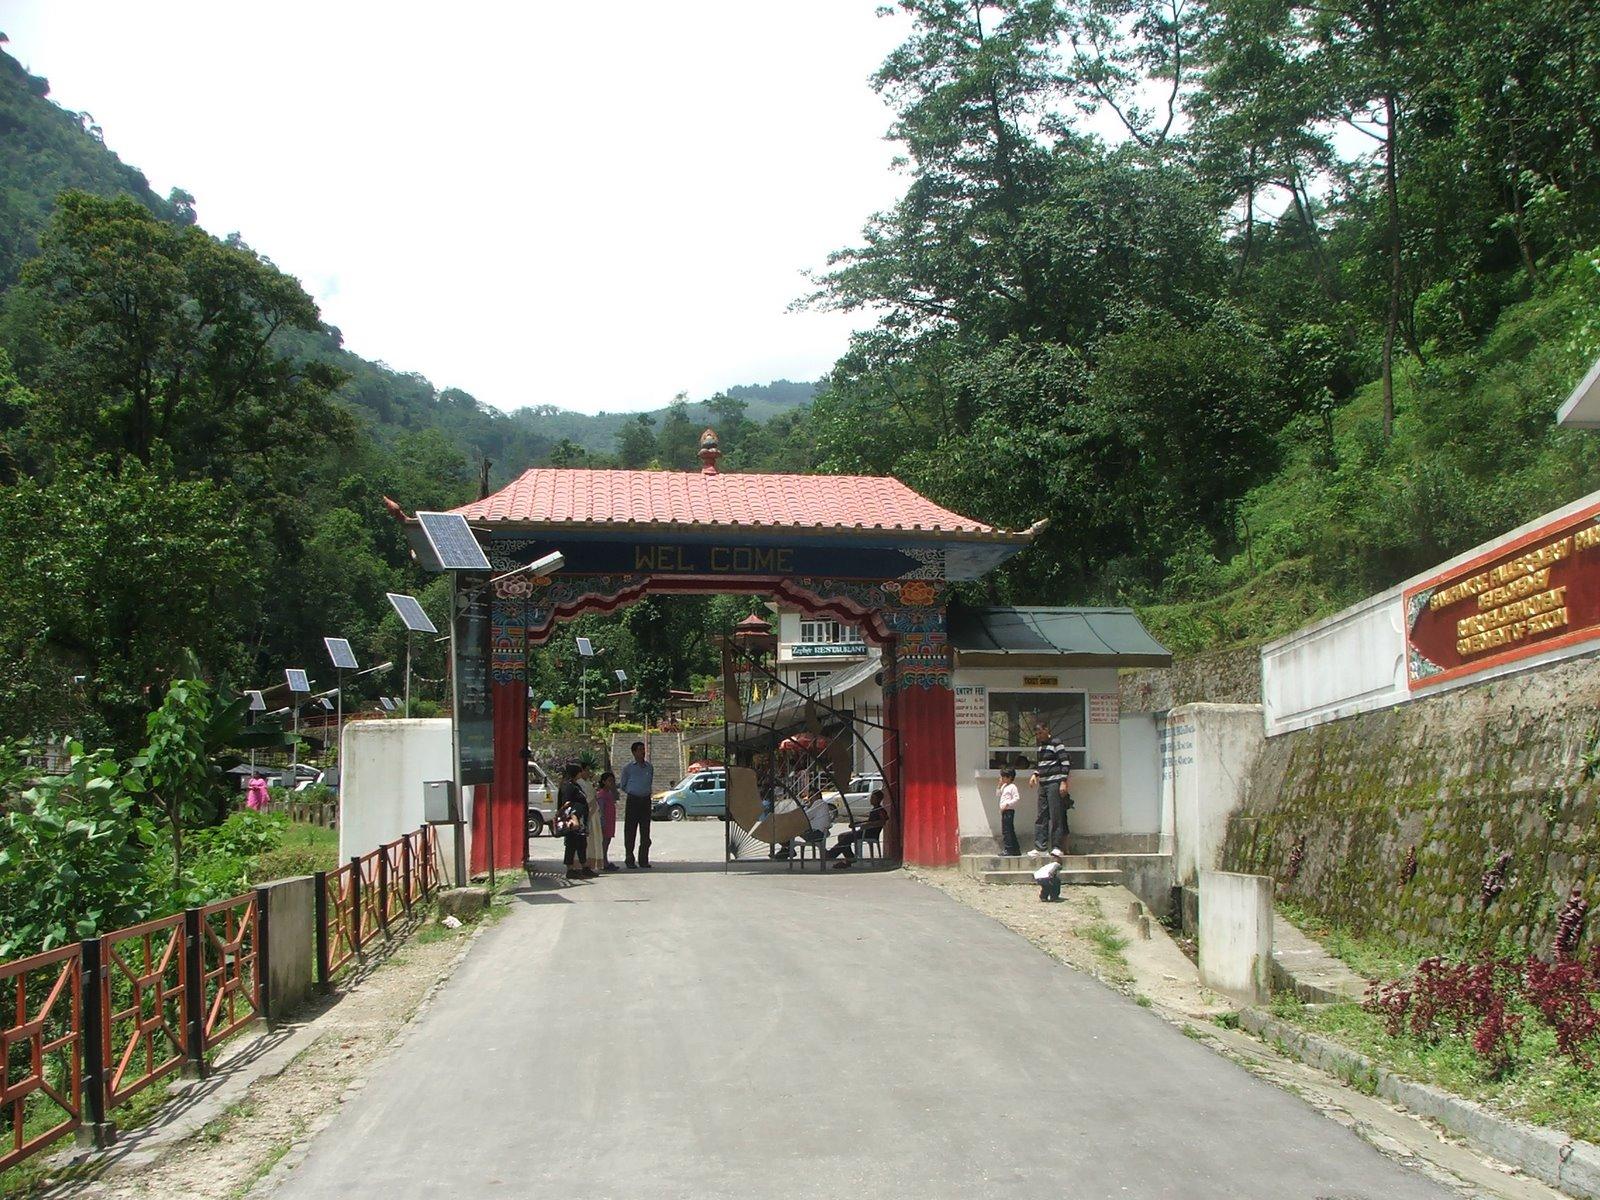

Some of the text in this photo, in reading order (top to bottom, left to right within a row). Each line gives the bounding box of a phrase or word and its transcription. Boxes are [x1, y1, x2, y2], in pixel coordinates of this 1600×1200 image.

[634, 545, 795, 572] WEL COME
[814, 646, 866, 654] RESTAURANT
[975, 687, 985, 695] FEE
